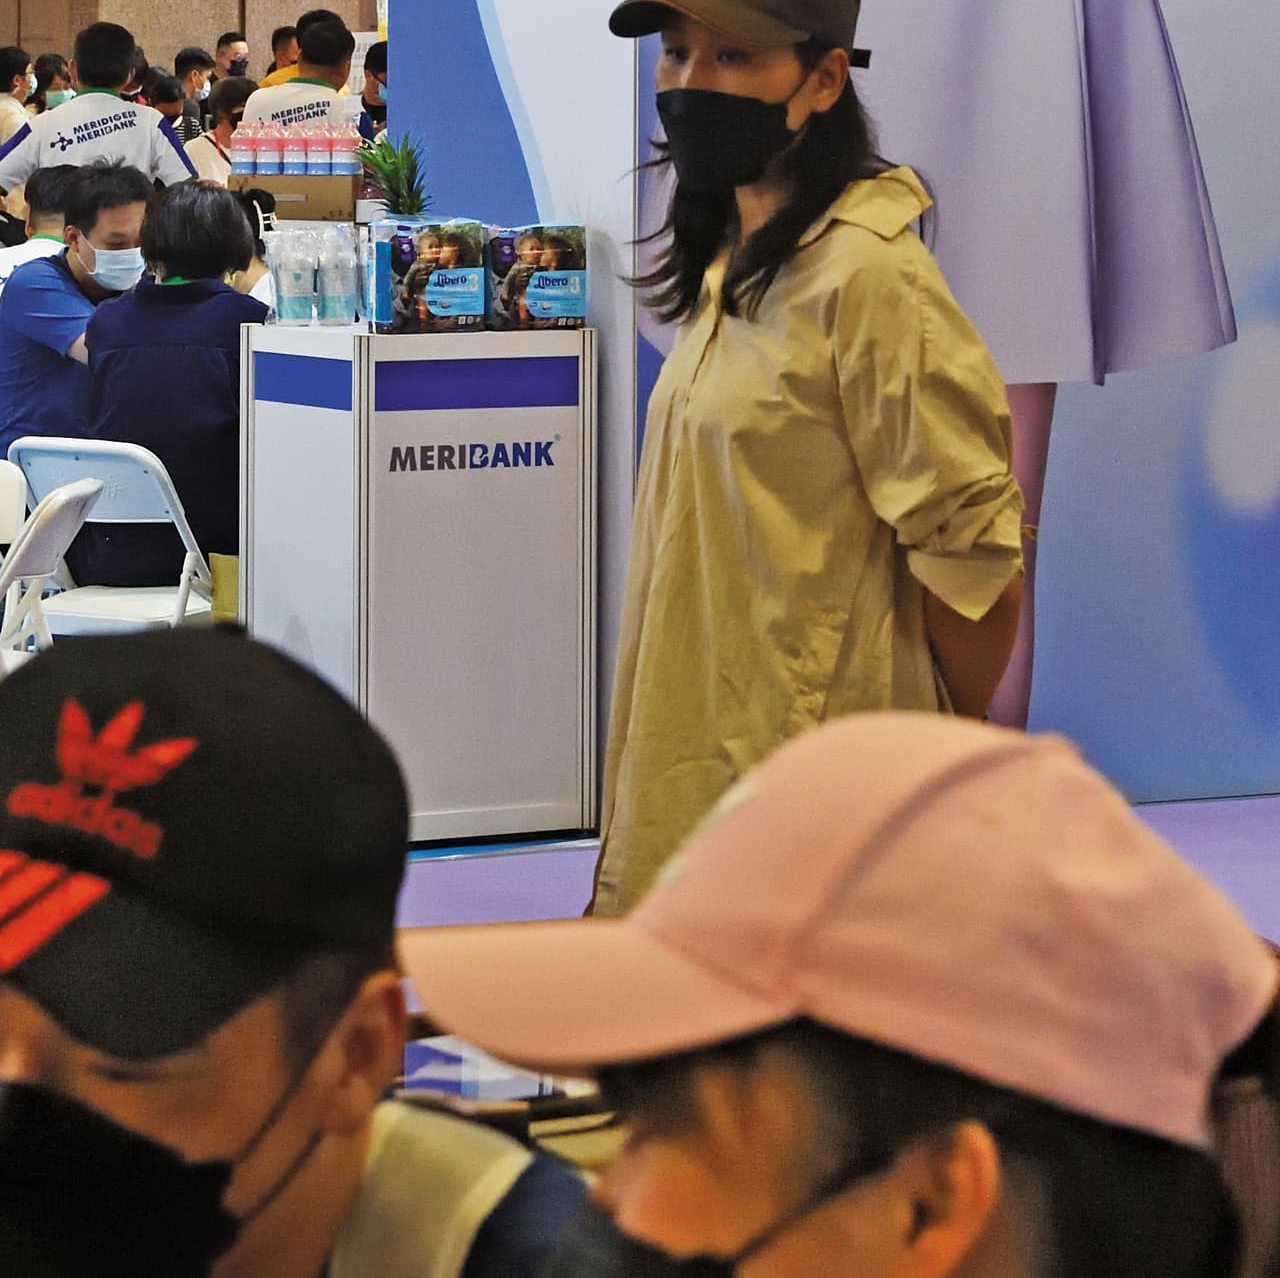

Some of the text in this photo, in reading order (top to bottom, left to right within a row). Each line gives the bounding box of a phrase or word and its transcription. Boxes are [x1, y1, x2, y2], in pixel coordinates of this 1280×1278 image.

[76, 119, 137, 144] MERIBANK
[433, 273, 467, 288] Libero
[7, 780, 164, 860] adidas
